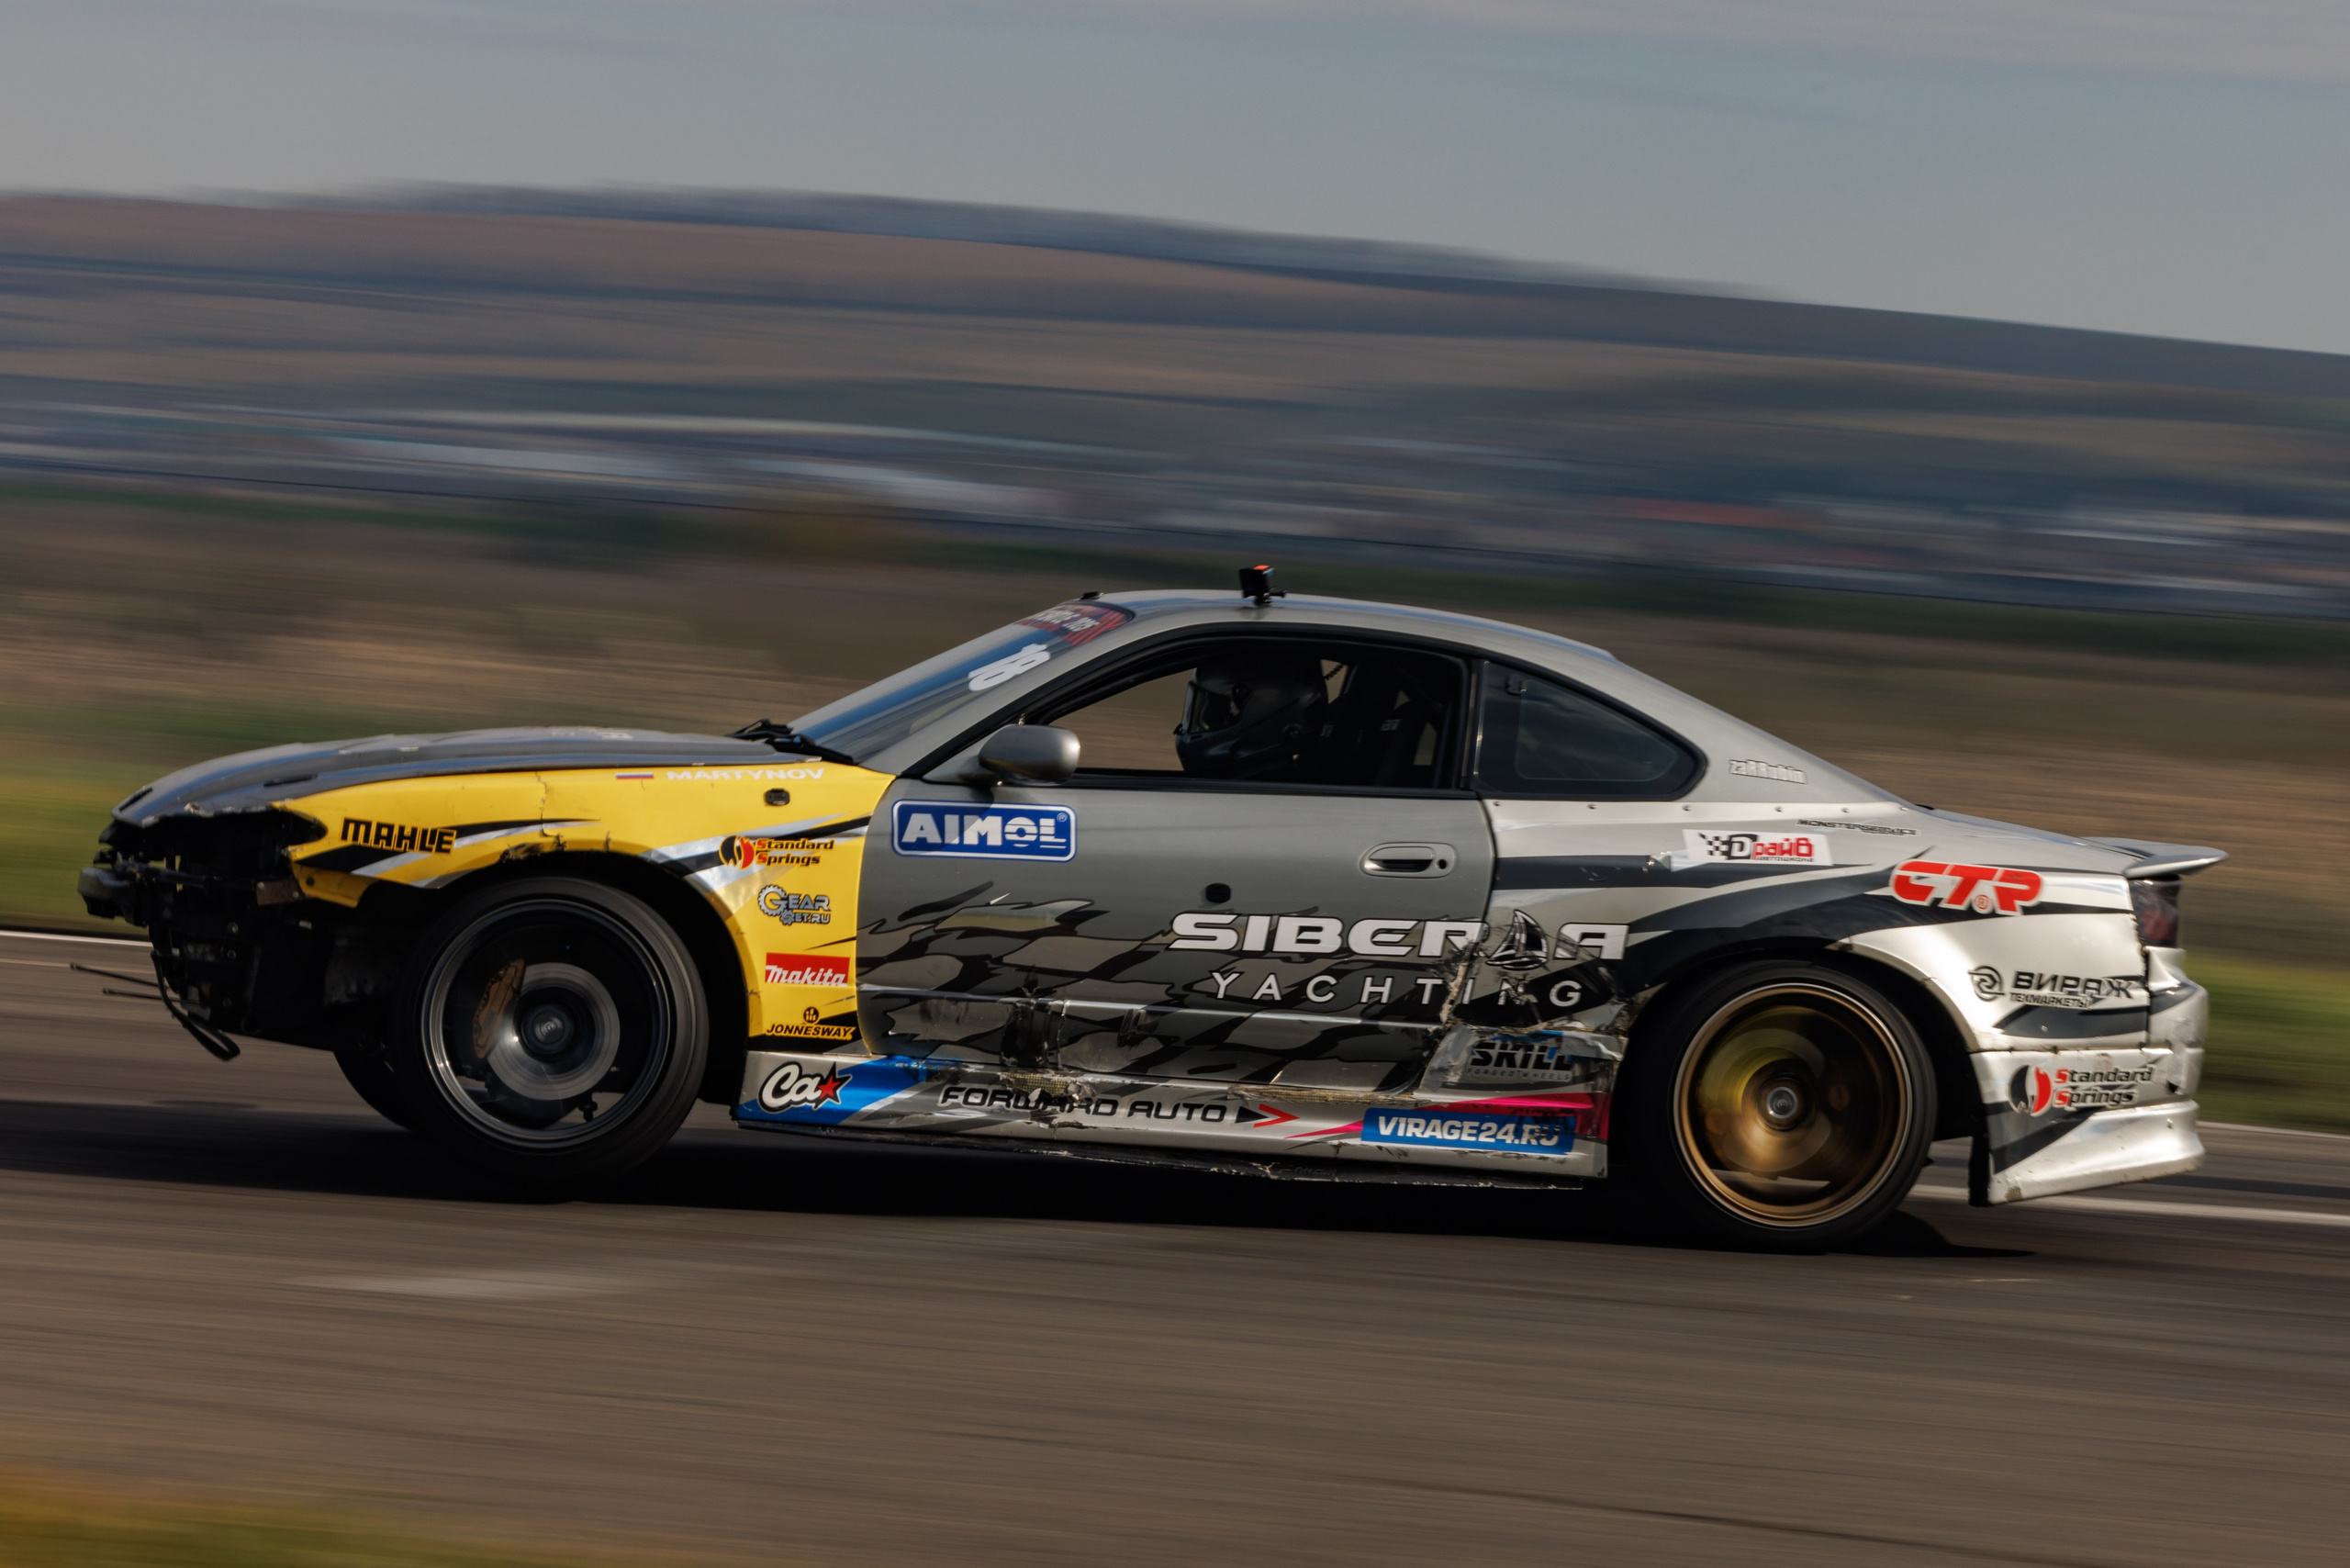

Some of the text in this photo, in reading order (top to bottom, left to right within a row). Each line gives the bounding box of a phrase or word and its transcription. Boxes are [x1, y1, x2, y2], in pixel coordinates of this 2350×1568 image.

[666, 768, 825, 780] MARTYNOV
[340, 816, 456, 855] MAHLE
[901, 812, 1068, 849] AIMOL
[756, 838, 834, 850] Standard
[756, 852, 821, 867] Springs
[1893, 860, 2043, 913] CTR
[757, 884, 831, 916] GEAR
[1212, 971, 1583, 1007] YACHTING
[2010, 970, 2135, 999] ВИРАЖ
[767, 1024, 855, 1038] JONNESWAY
[1470, 1039, 1572, 1071] SKILL
[1467, 1068, 1571, 1081] FORGED WHEELS
[2055, 1066, 2154, 1084] Standard
[2055, 1089, 2136, 1106] Springs
[1127, 1101, 1227, 1123] AUTO
[1378, 1115, 1561, 1147] VIRAGE24.RU
